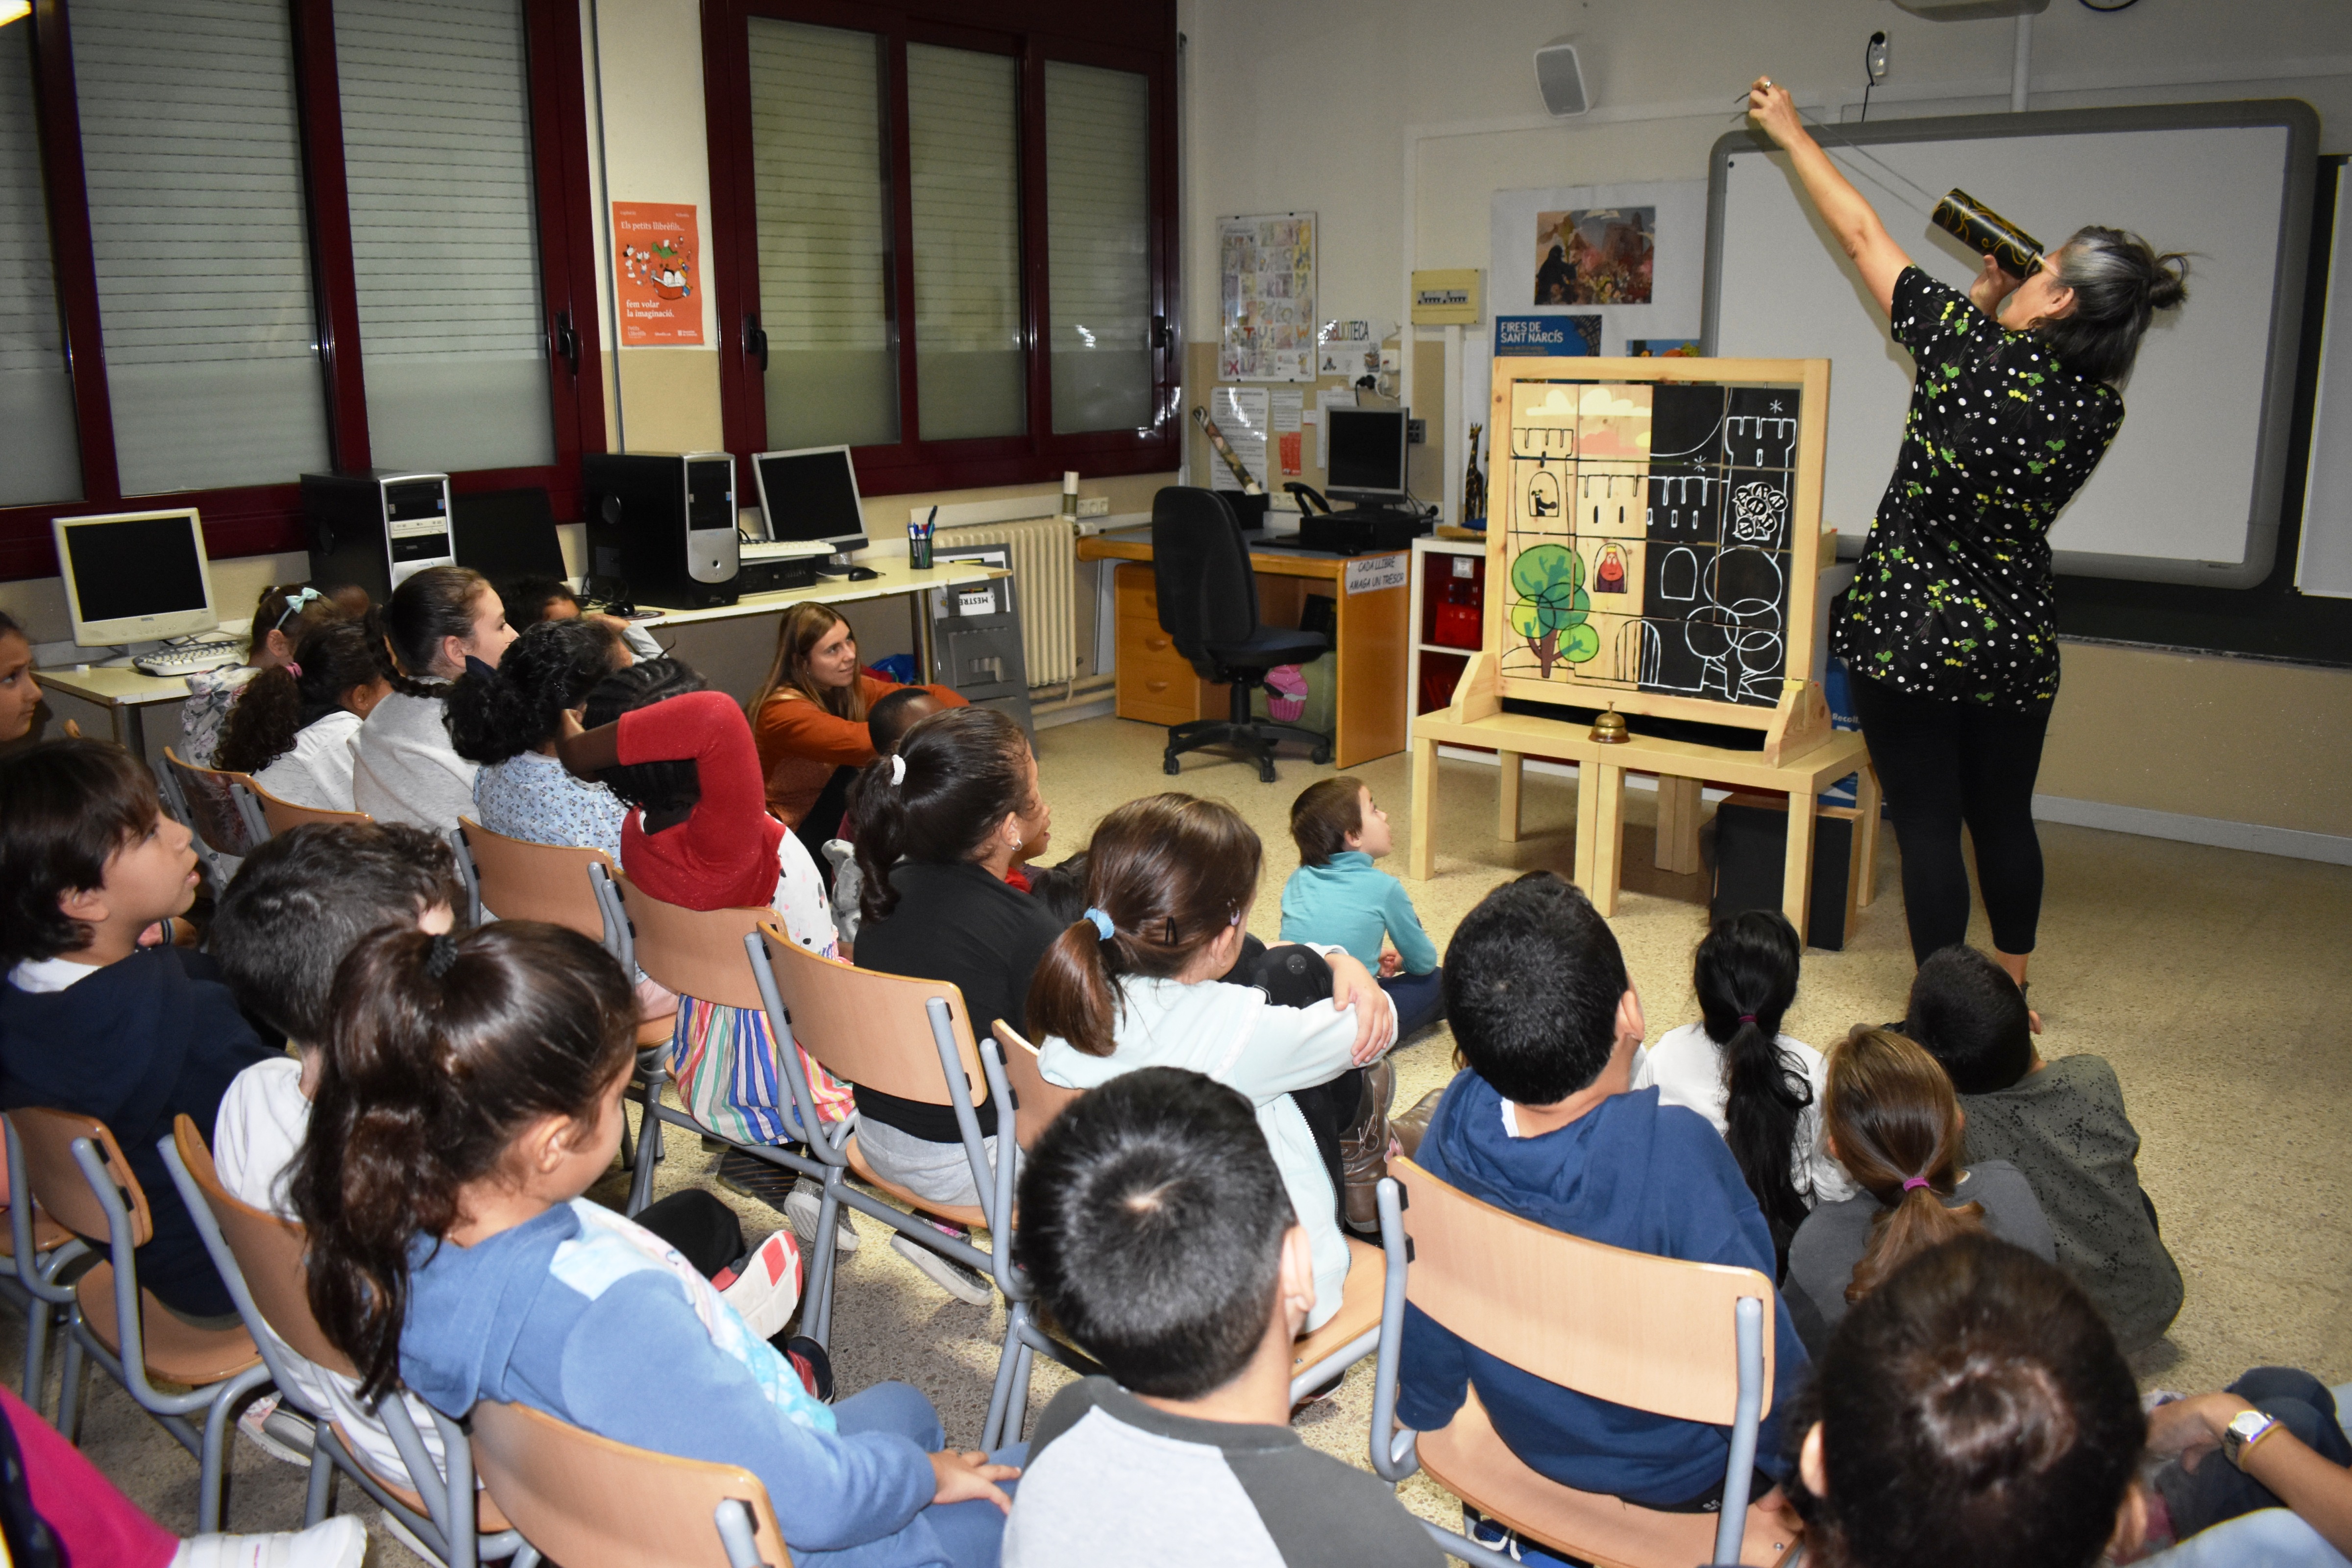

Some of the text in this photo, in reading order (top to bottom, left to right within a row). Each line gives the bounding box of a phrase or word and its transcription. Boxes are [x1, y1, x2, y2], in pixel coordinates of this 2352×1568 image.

[632, 222, 651, 231] petits
[626, 299, 660, 308] fem volar
[627, 309, 633, 317] la
[1501, 321, 1541, 333] FIRES DE
[1501, 332, 1525, 343] SANT
[1748, 500, 1764, 513] Ai
[1358, 562, 1373, 572] CADA
[1349, 578, 1371, 590] AMAGA
[959, 596, 988, 606] MESTRE
